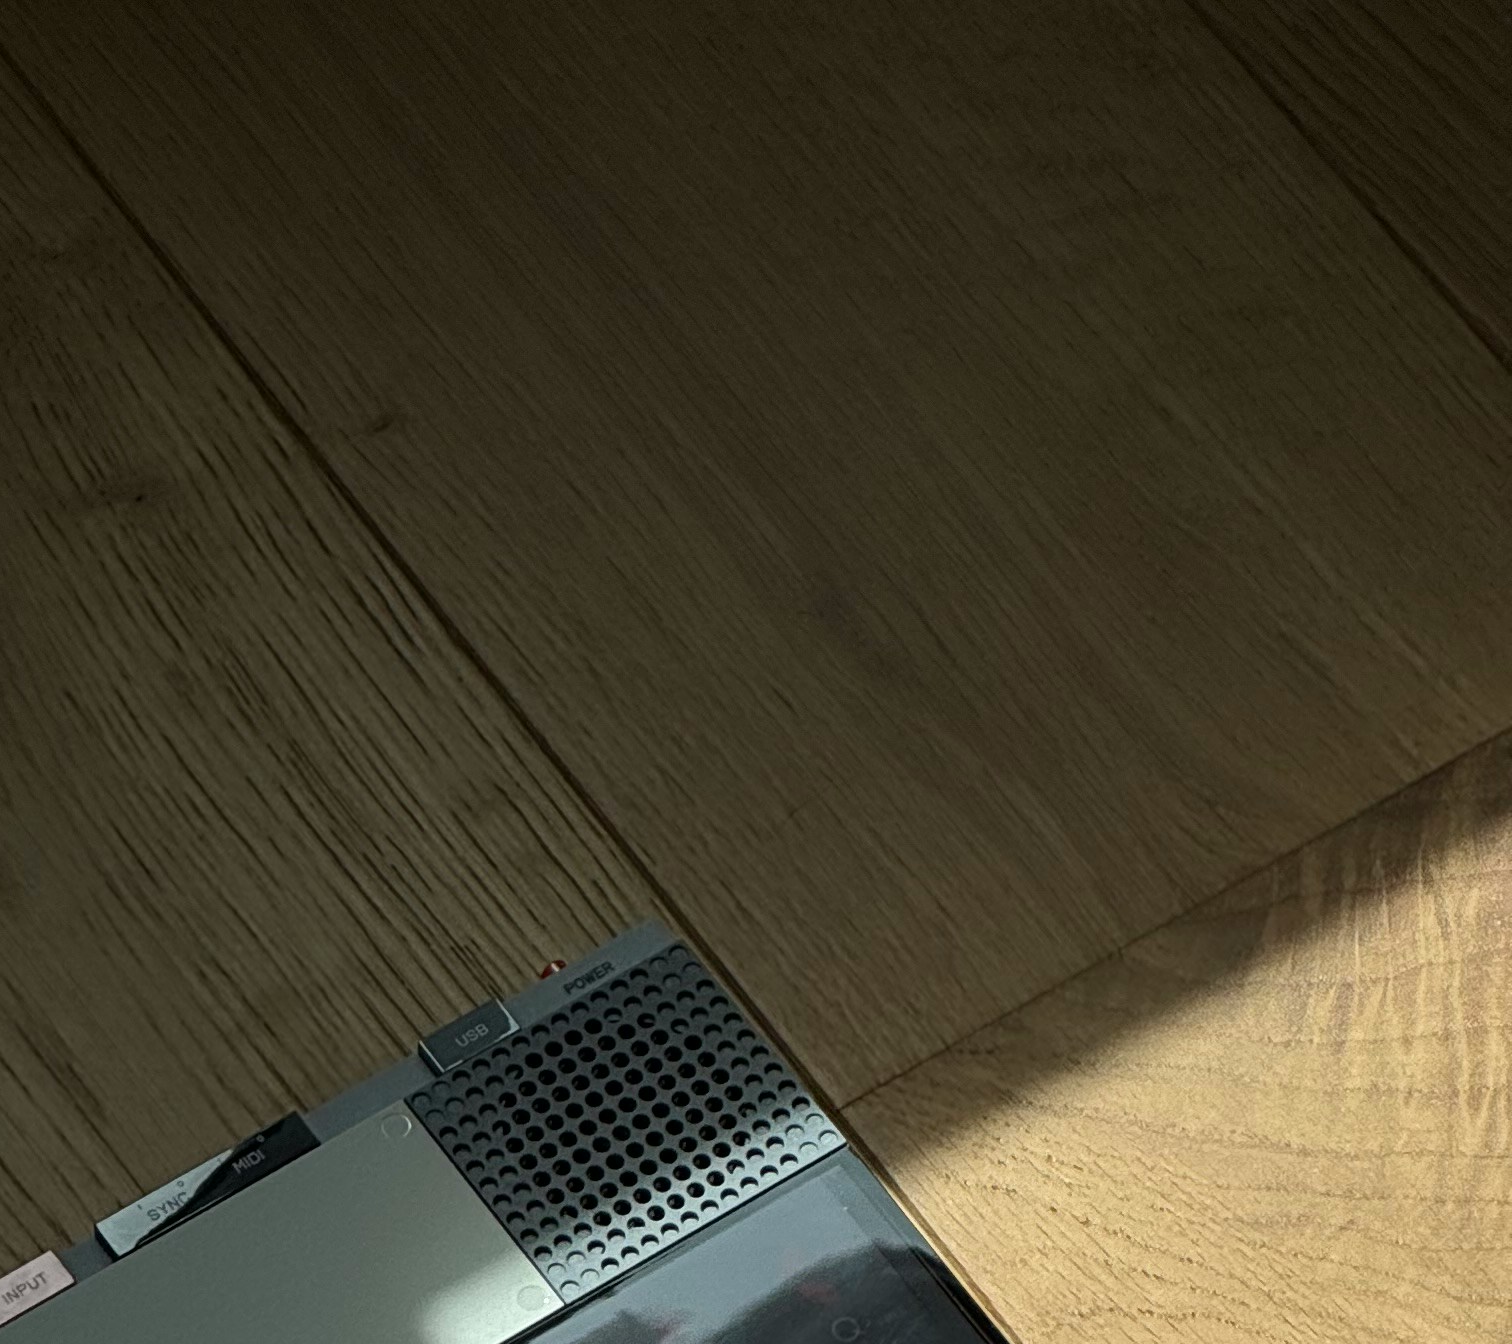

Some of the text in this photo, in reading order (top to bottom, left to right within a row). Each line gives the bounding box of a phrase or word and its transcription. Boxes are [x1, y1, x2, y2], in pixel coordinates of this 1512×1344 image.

[562, 959, 616, 996] POWER
[453, 1022, 491, 1049] USB
[231, 1148, 267, 1174] MIDI
[0, 1270, 51, 1305] INPUT
